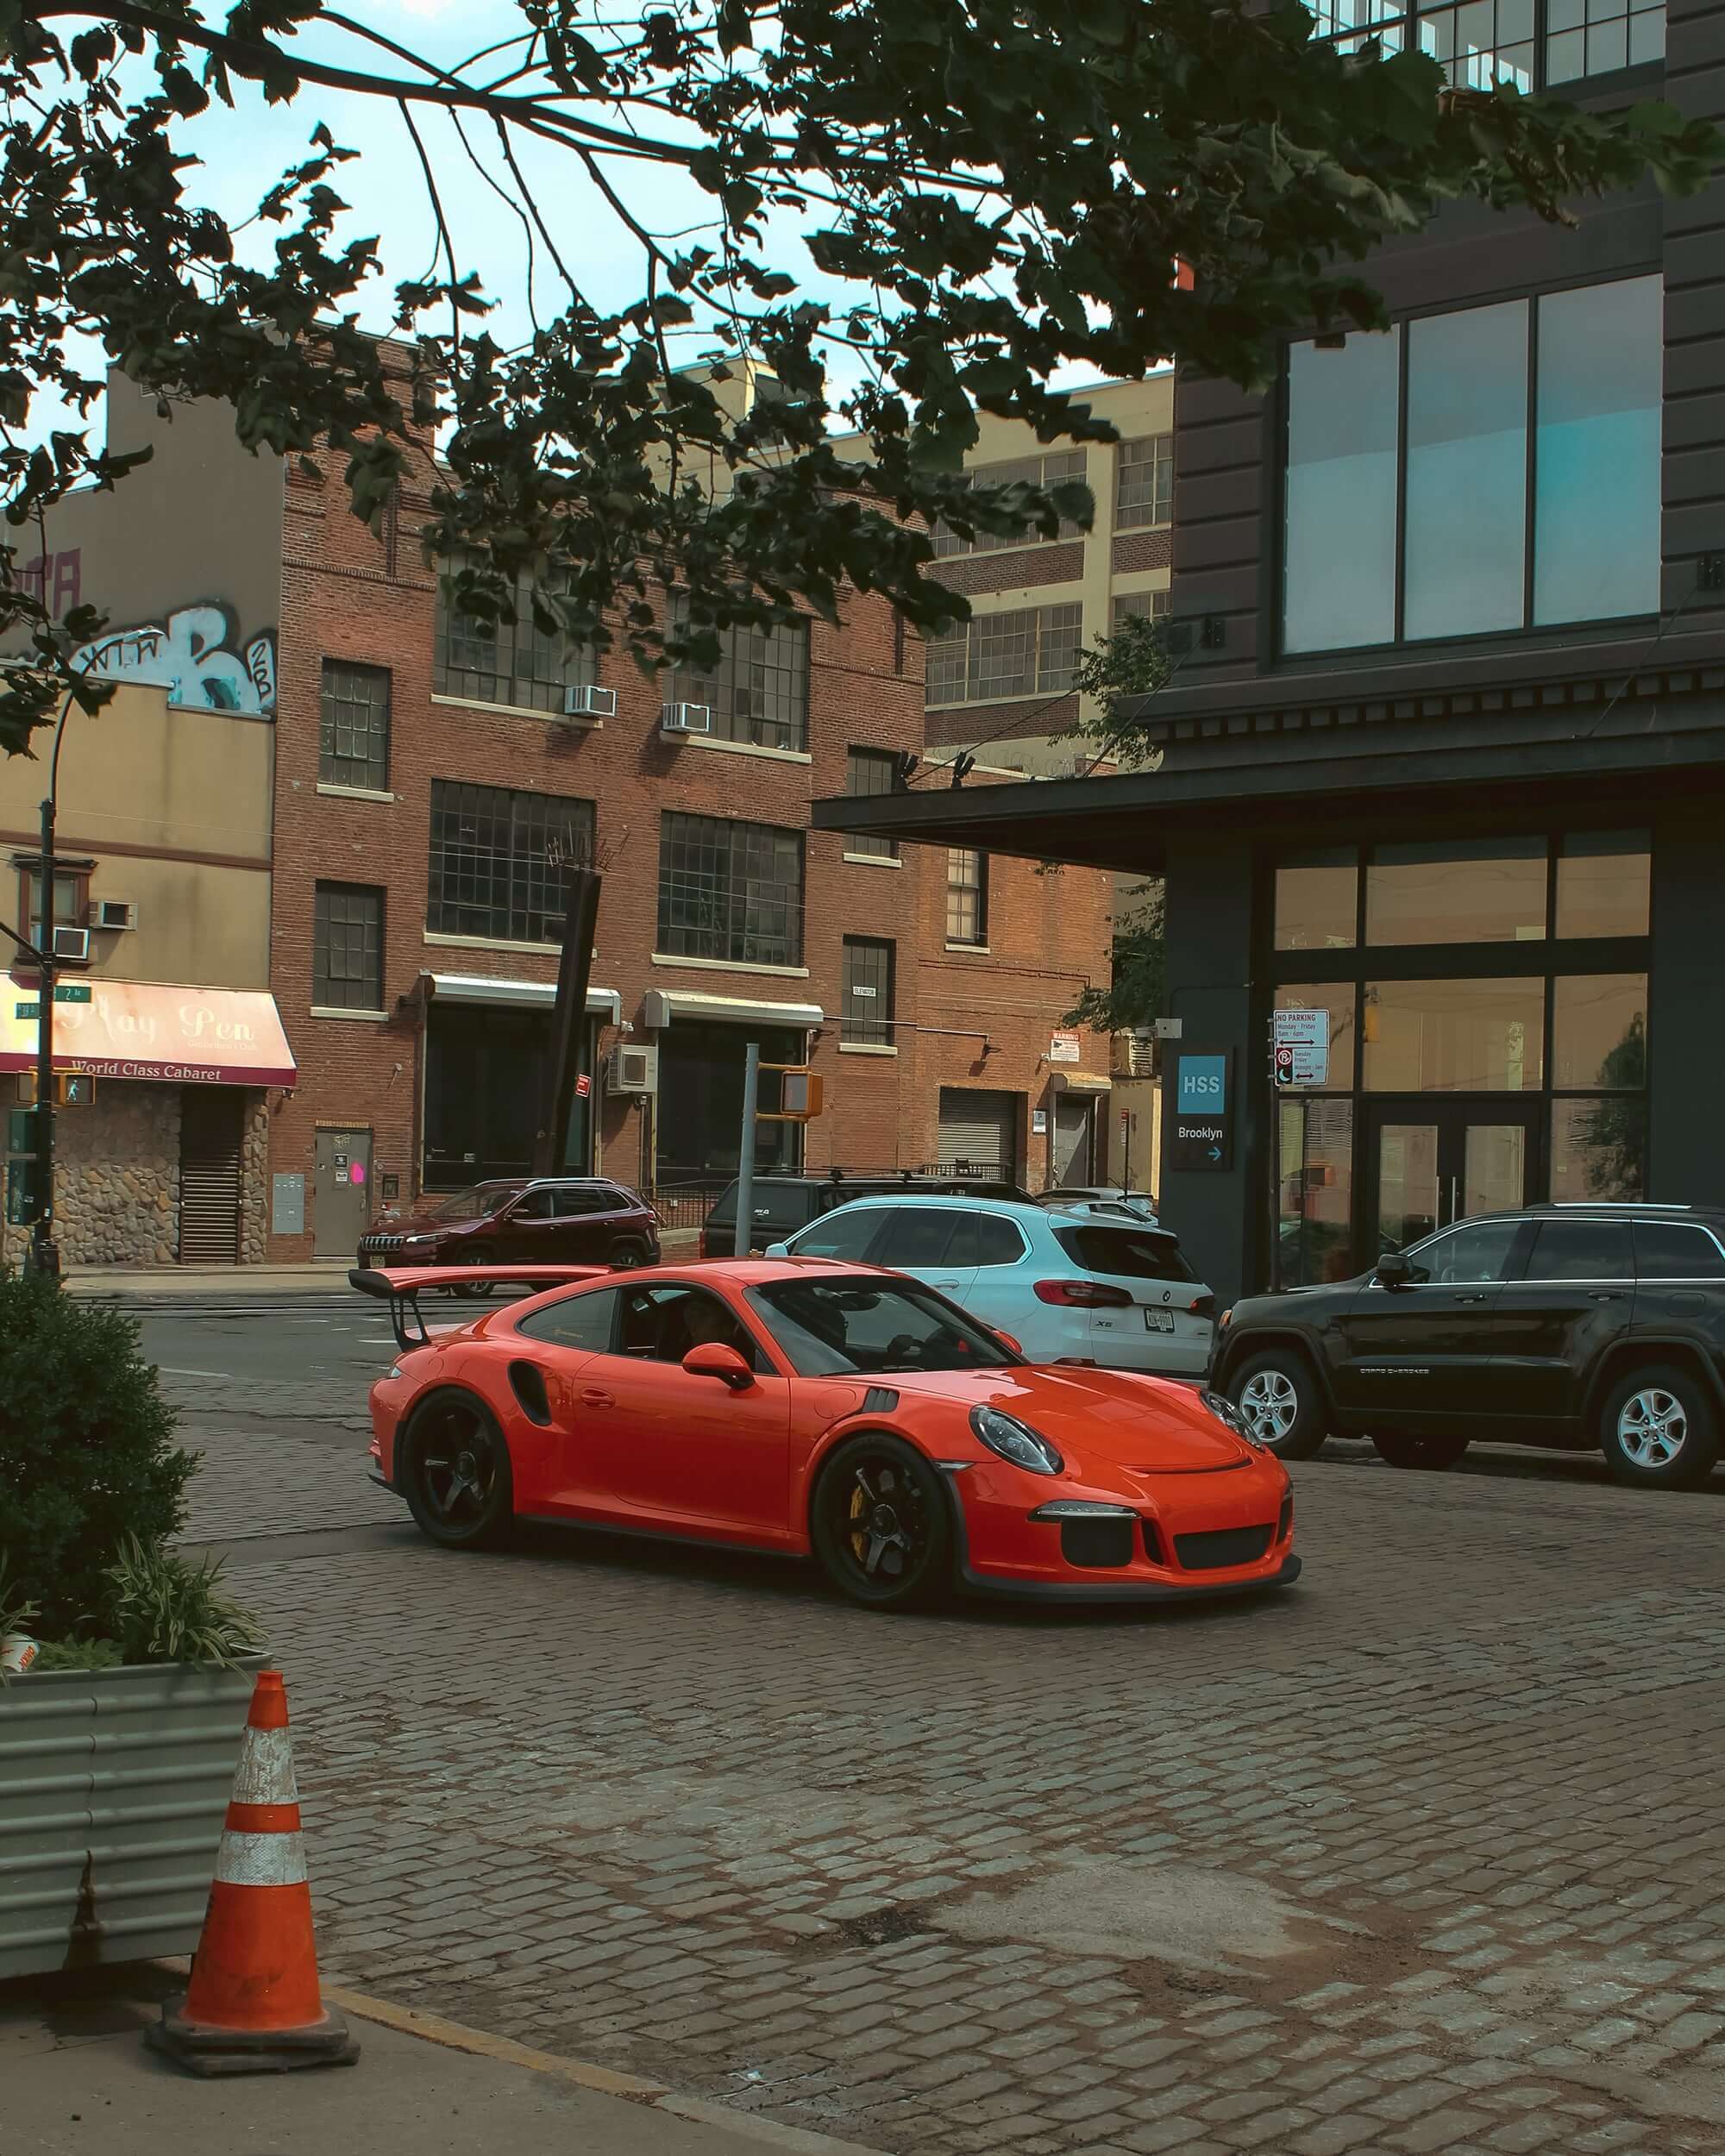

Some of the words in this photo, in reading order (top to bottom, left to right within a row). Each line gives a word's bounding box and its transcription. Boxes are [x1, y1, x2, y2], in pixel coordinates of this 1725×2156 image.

[66, 987, 71, 1000] 2
[179, 1004, 255, 1041] Pen
[71, 1060, 118, 1075] World
[122, 1062, 160, 1077] Class
[164, 1065, 222, 1081] Cabaret
[1184, 1075, 1220, 1094] HSS
[1178, 1126, 1223, 1141] Brooklyn
